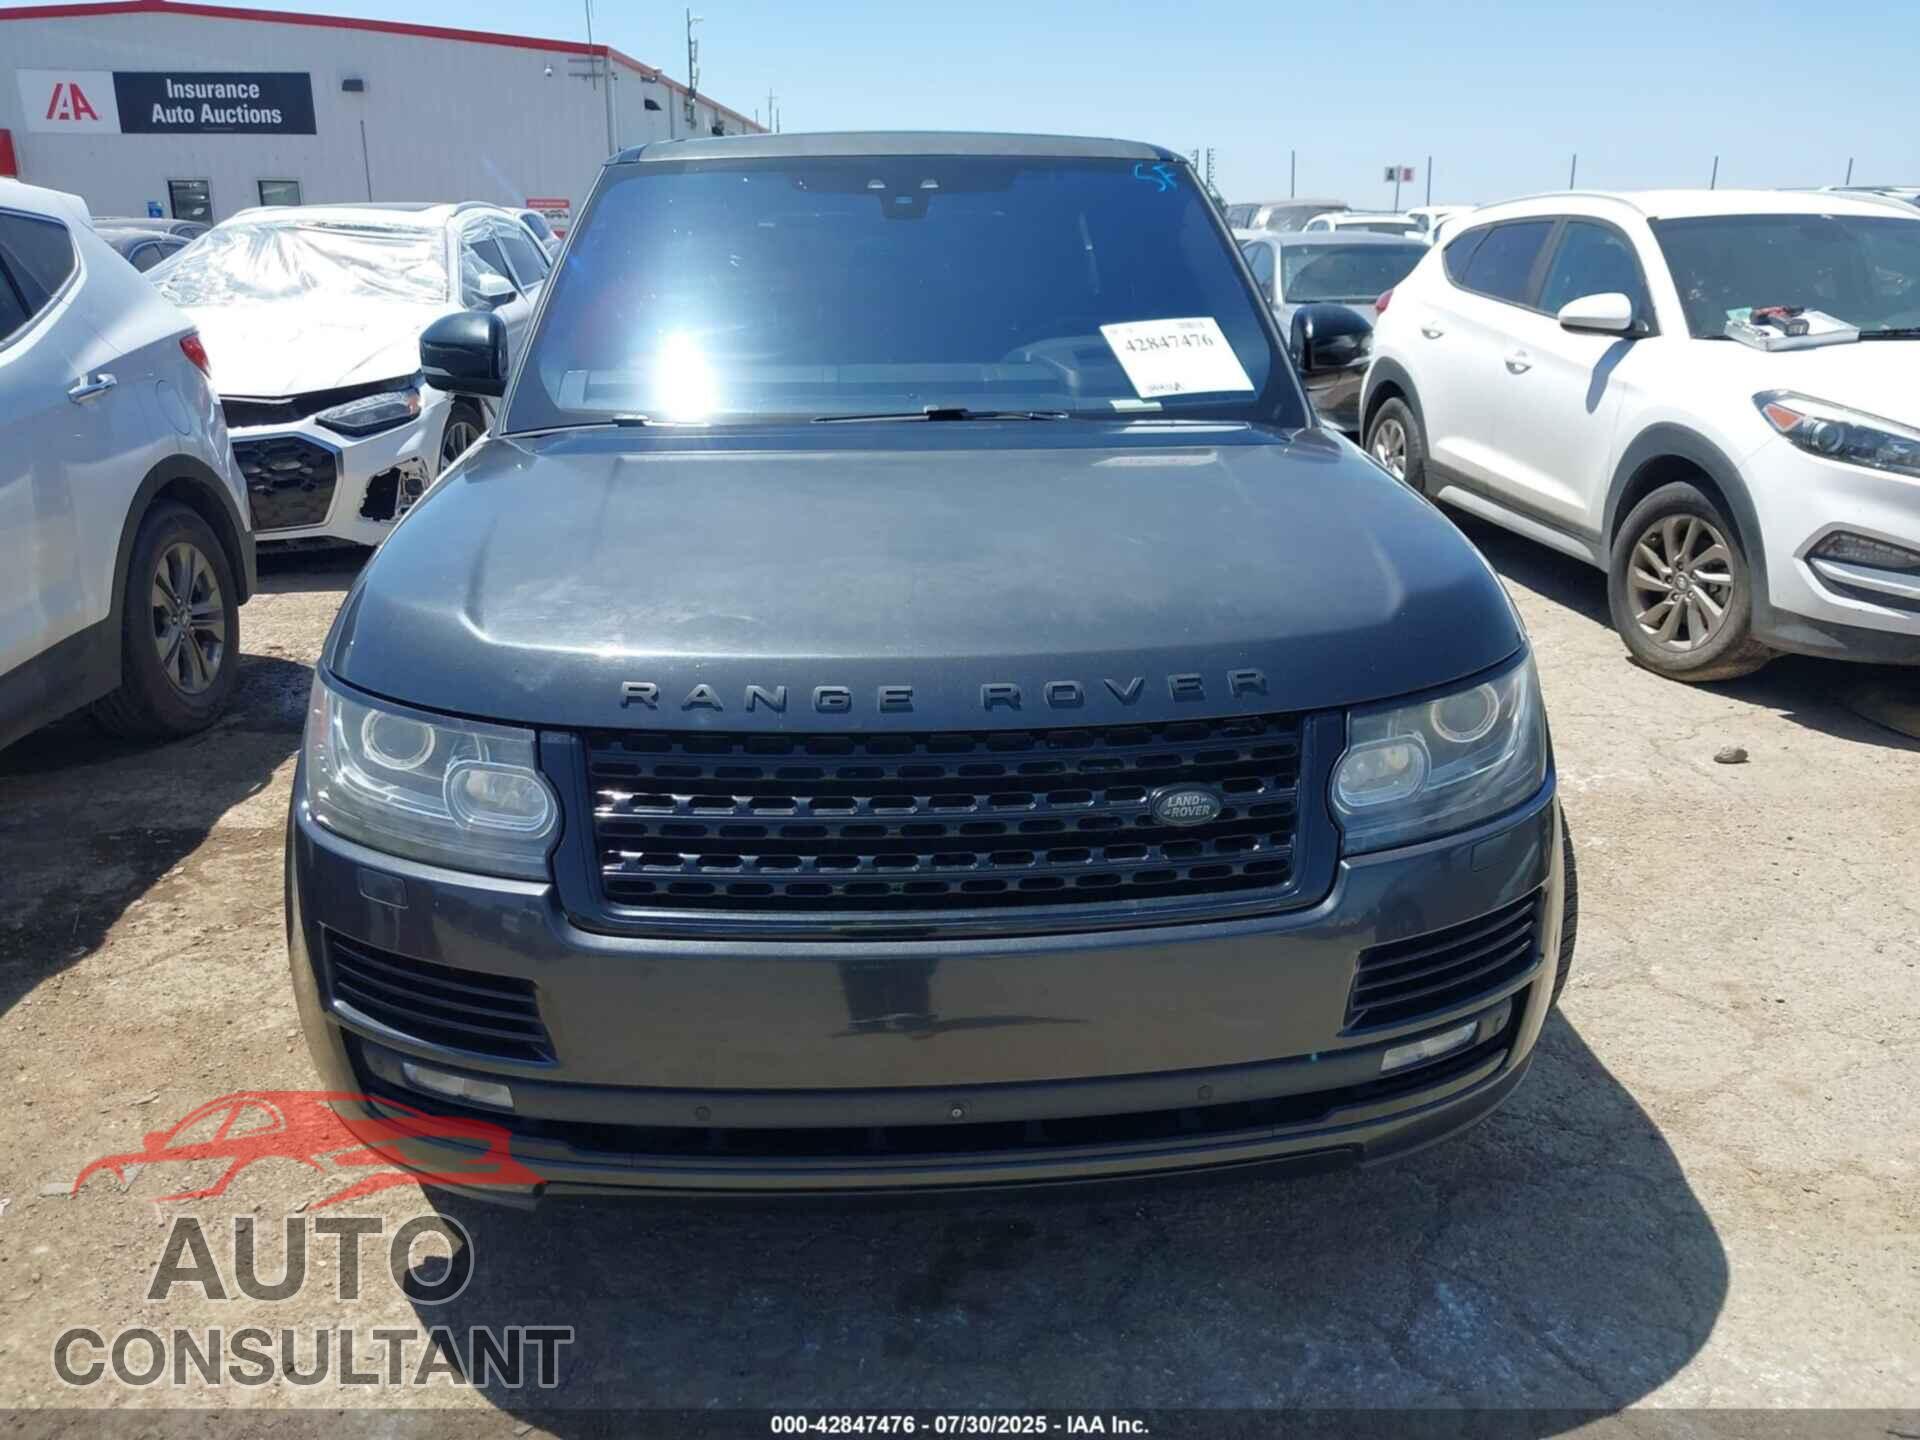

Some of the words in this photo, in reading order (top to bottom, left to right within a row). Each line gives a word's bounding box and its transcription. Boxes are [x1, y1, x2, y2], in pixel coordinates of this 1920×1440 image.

[166, 78, 260, 99] Insurance
[152, 104, 195, 124] Auto
[201, 104, 282, 124] Auctions
[1125, 334, 1214, 352] 42847476
[620, 680, 914, 713] RANGE
[980, 668, 1270, 711] ROVER
[1168, 795, 1200, 808] LAND
[1171, 804, 1210, 818] ROVER
